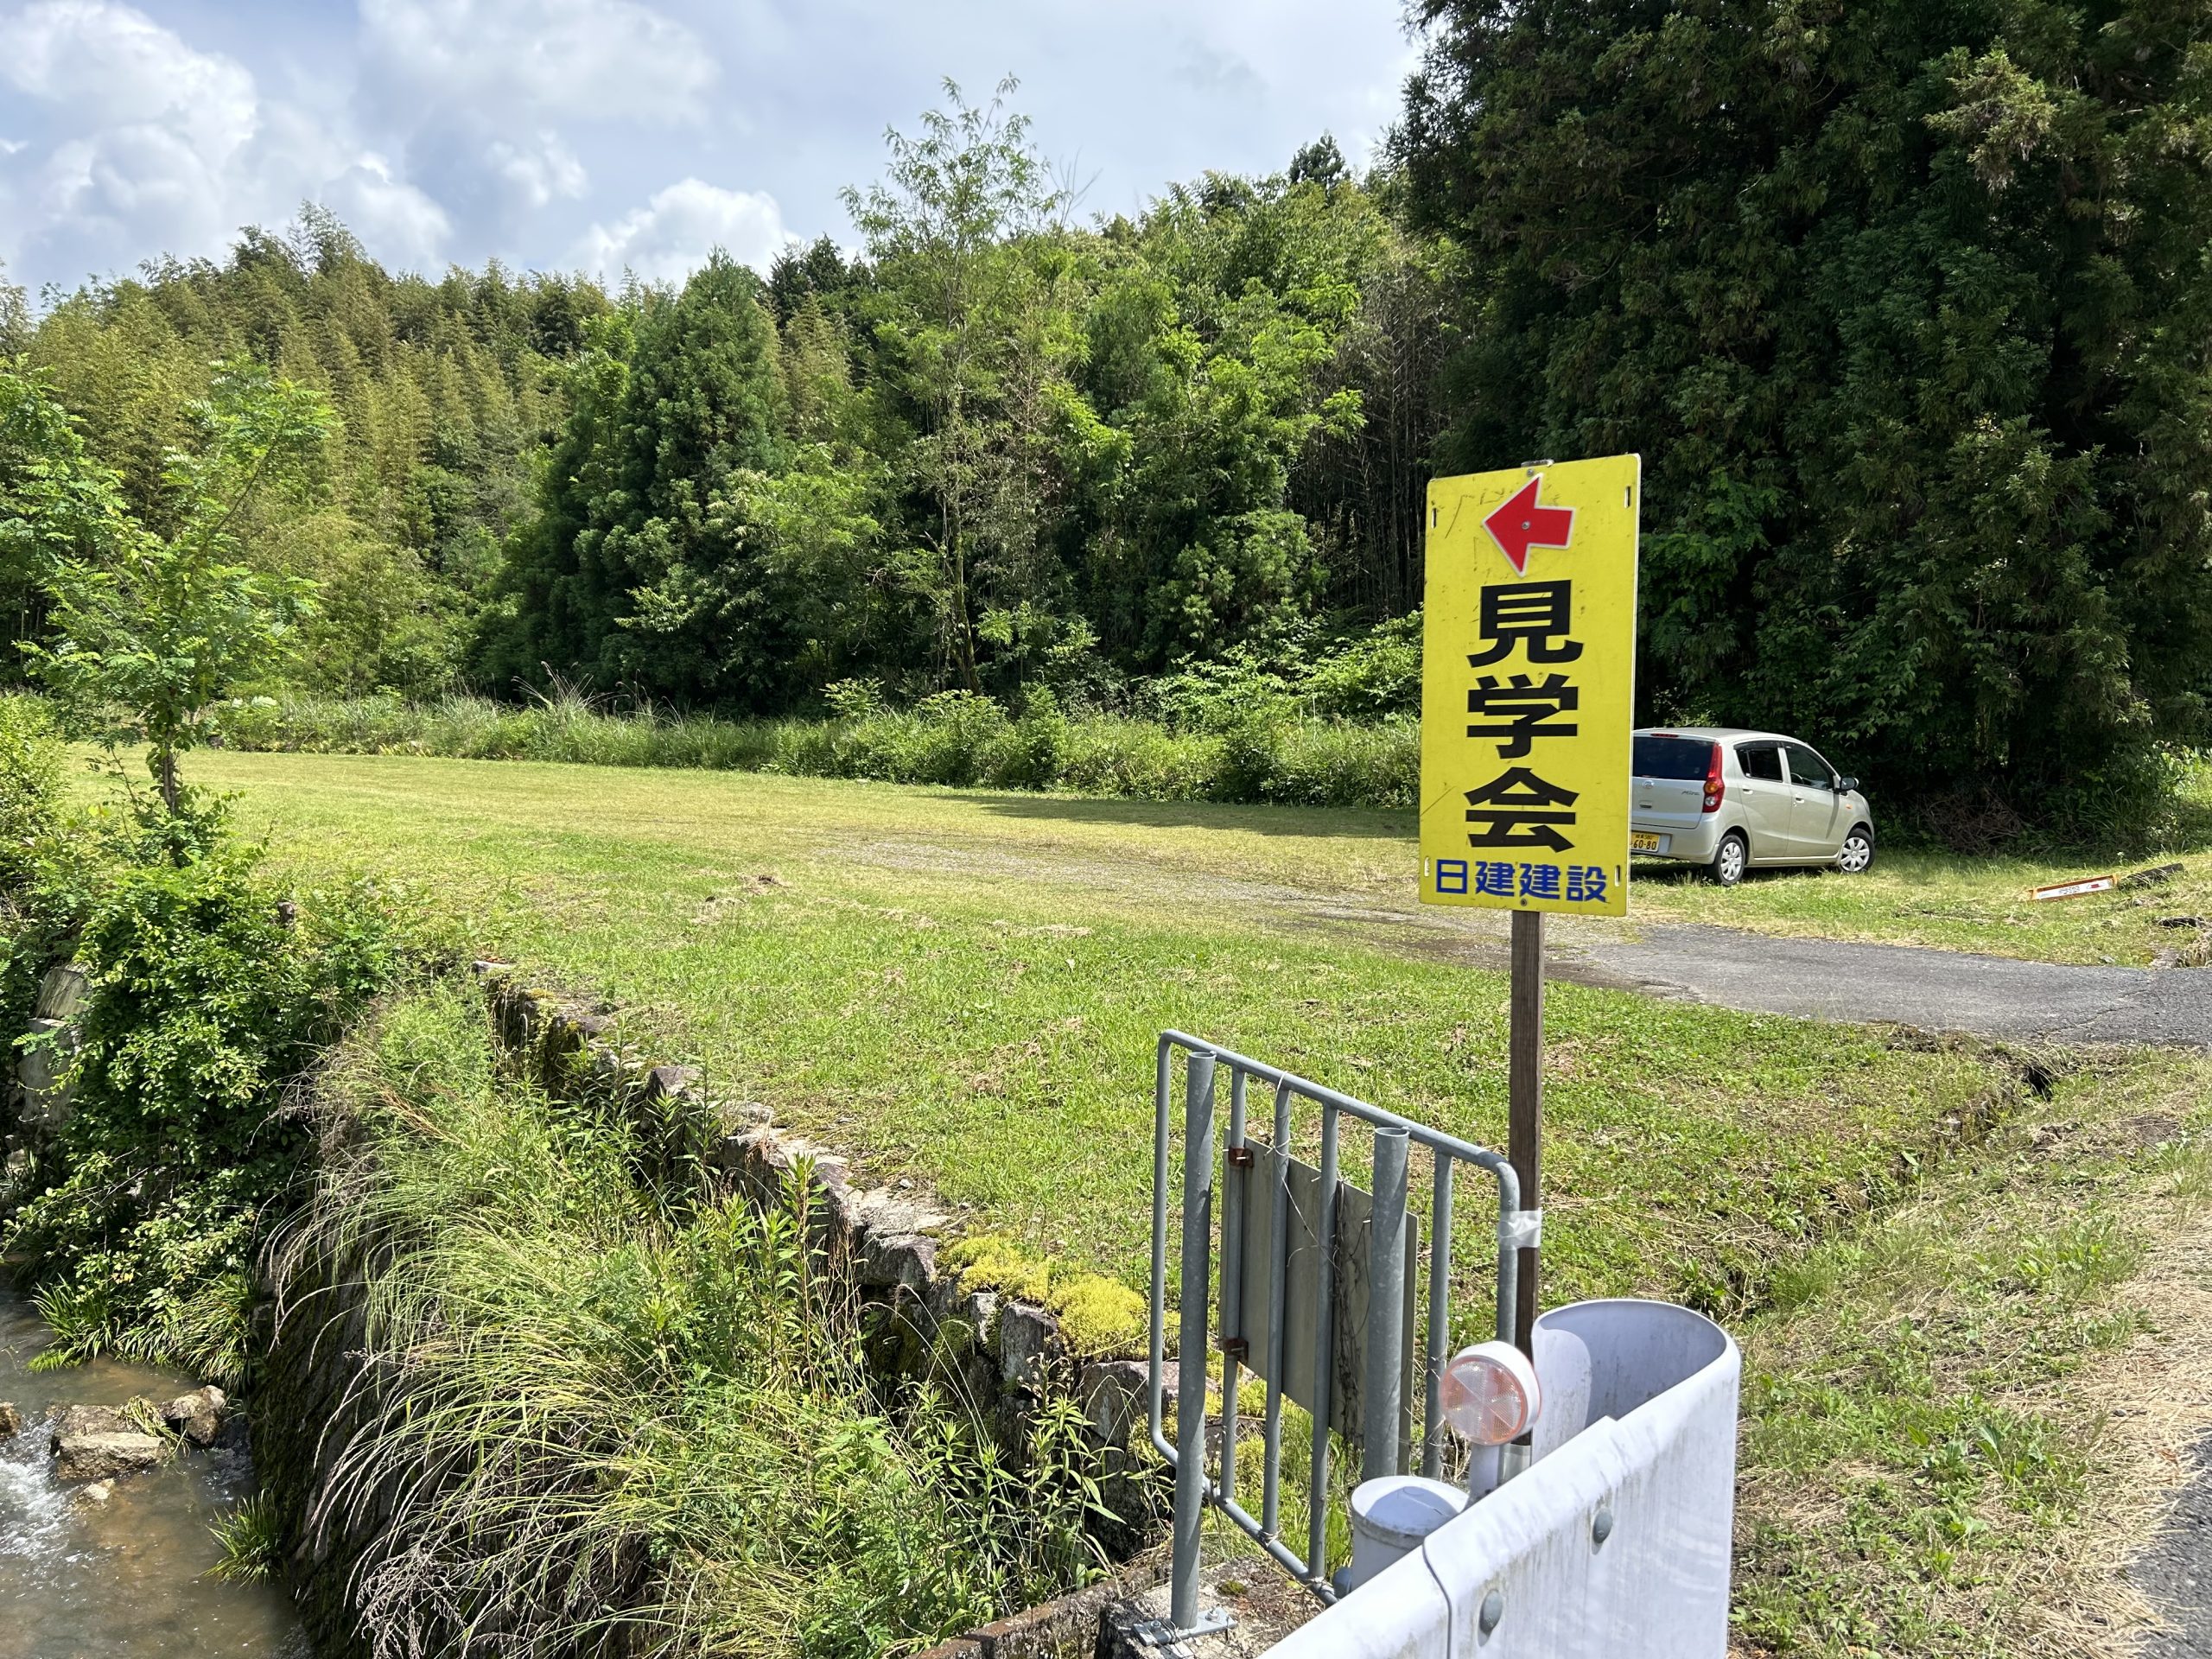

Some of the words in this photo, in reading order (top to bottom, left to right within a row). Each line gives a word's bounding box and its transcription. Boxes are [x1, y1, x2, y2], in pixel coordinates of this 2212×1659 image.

[1464, 580, 1584, 853] 見学会
[1633, 839, 1656, 850] 60-80
[1436, 859, 1607, 903] 日建建設
